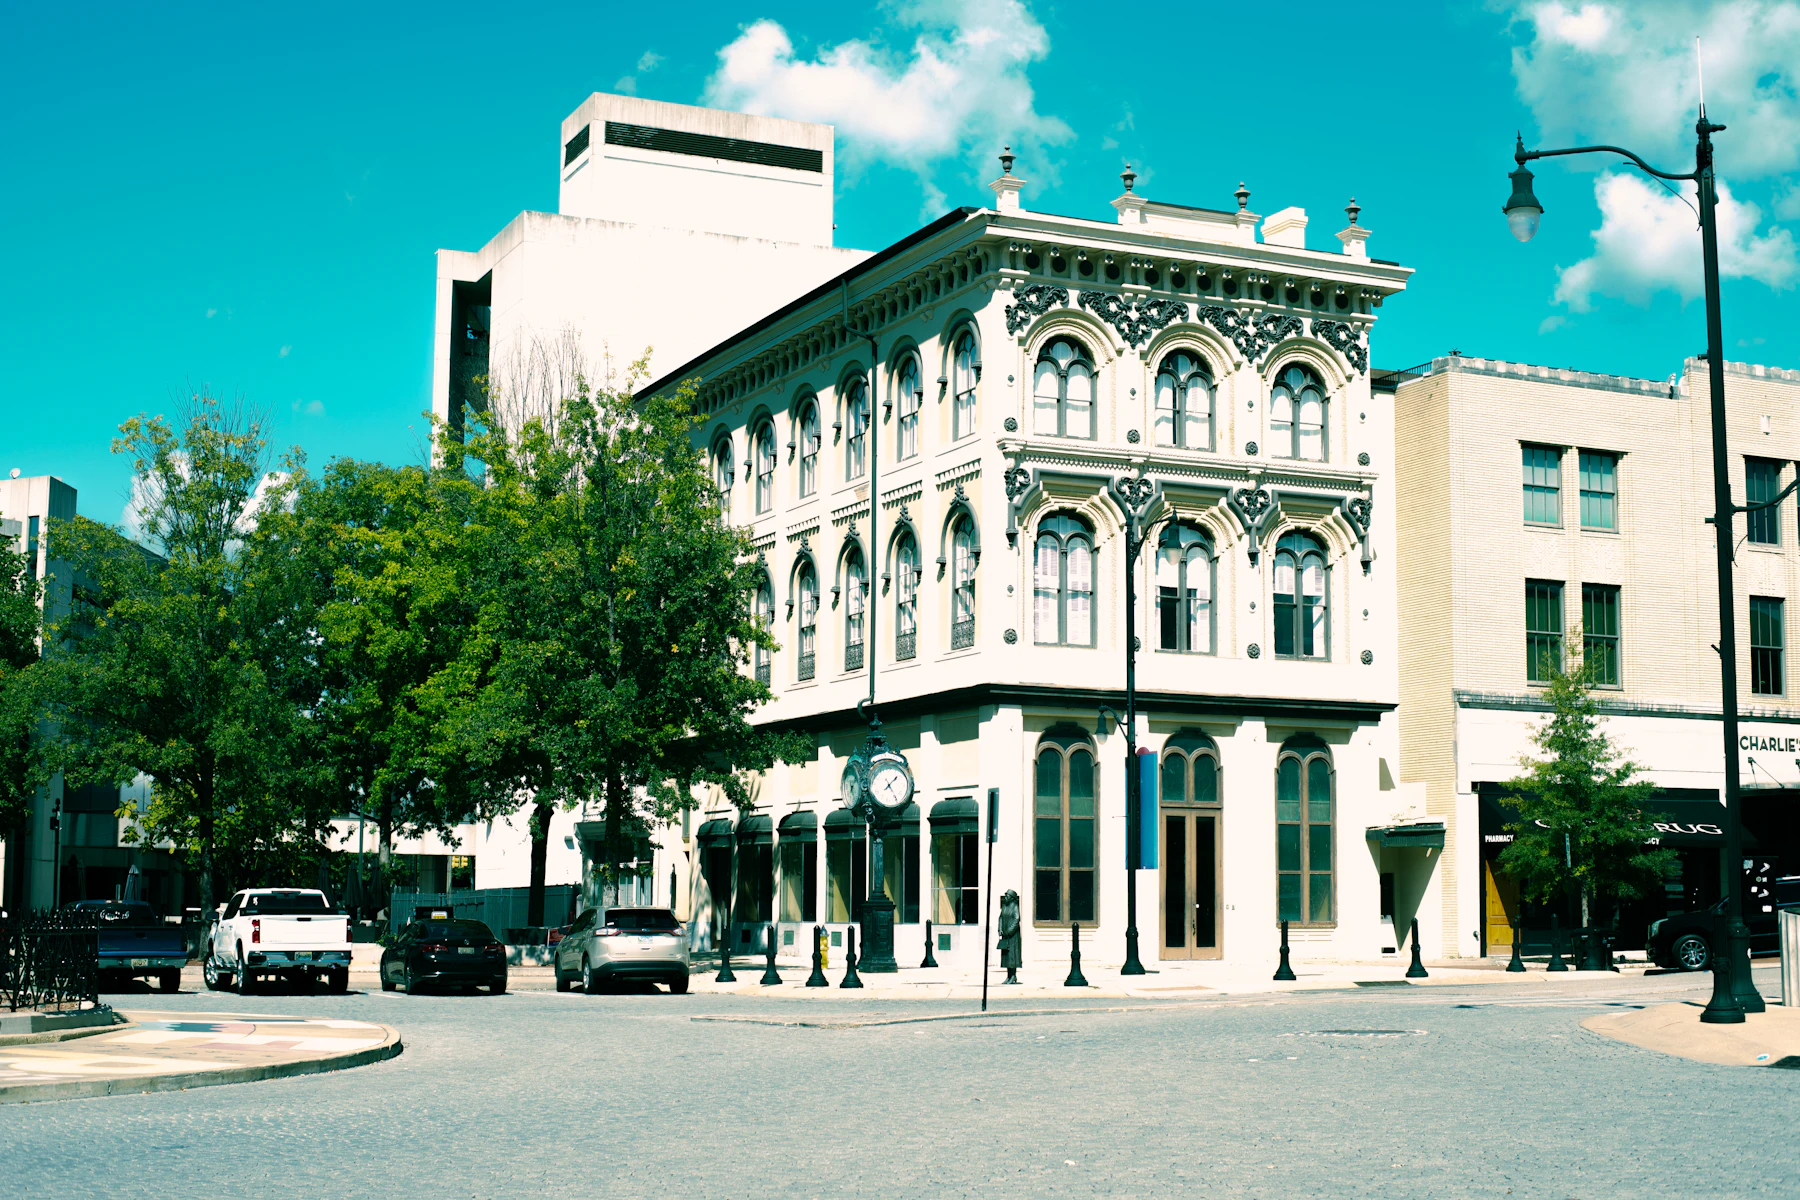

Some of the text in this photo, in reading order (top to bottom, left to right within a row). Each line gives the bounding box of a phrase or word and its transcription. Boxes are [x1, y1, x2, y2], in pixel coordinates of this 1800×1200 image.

[1739, 735, 1800, 752] CHARLIE'
[1636, 822, 1723, 835] RUG
[1485, 834, 1514, 843] PHARMACY
